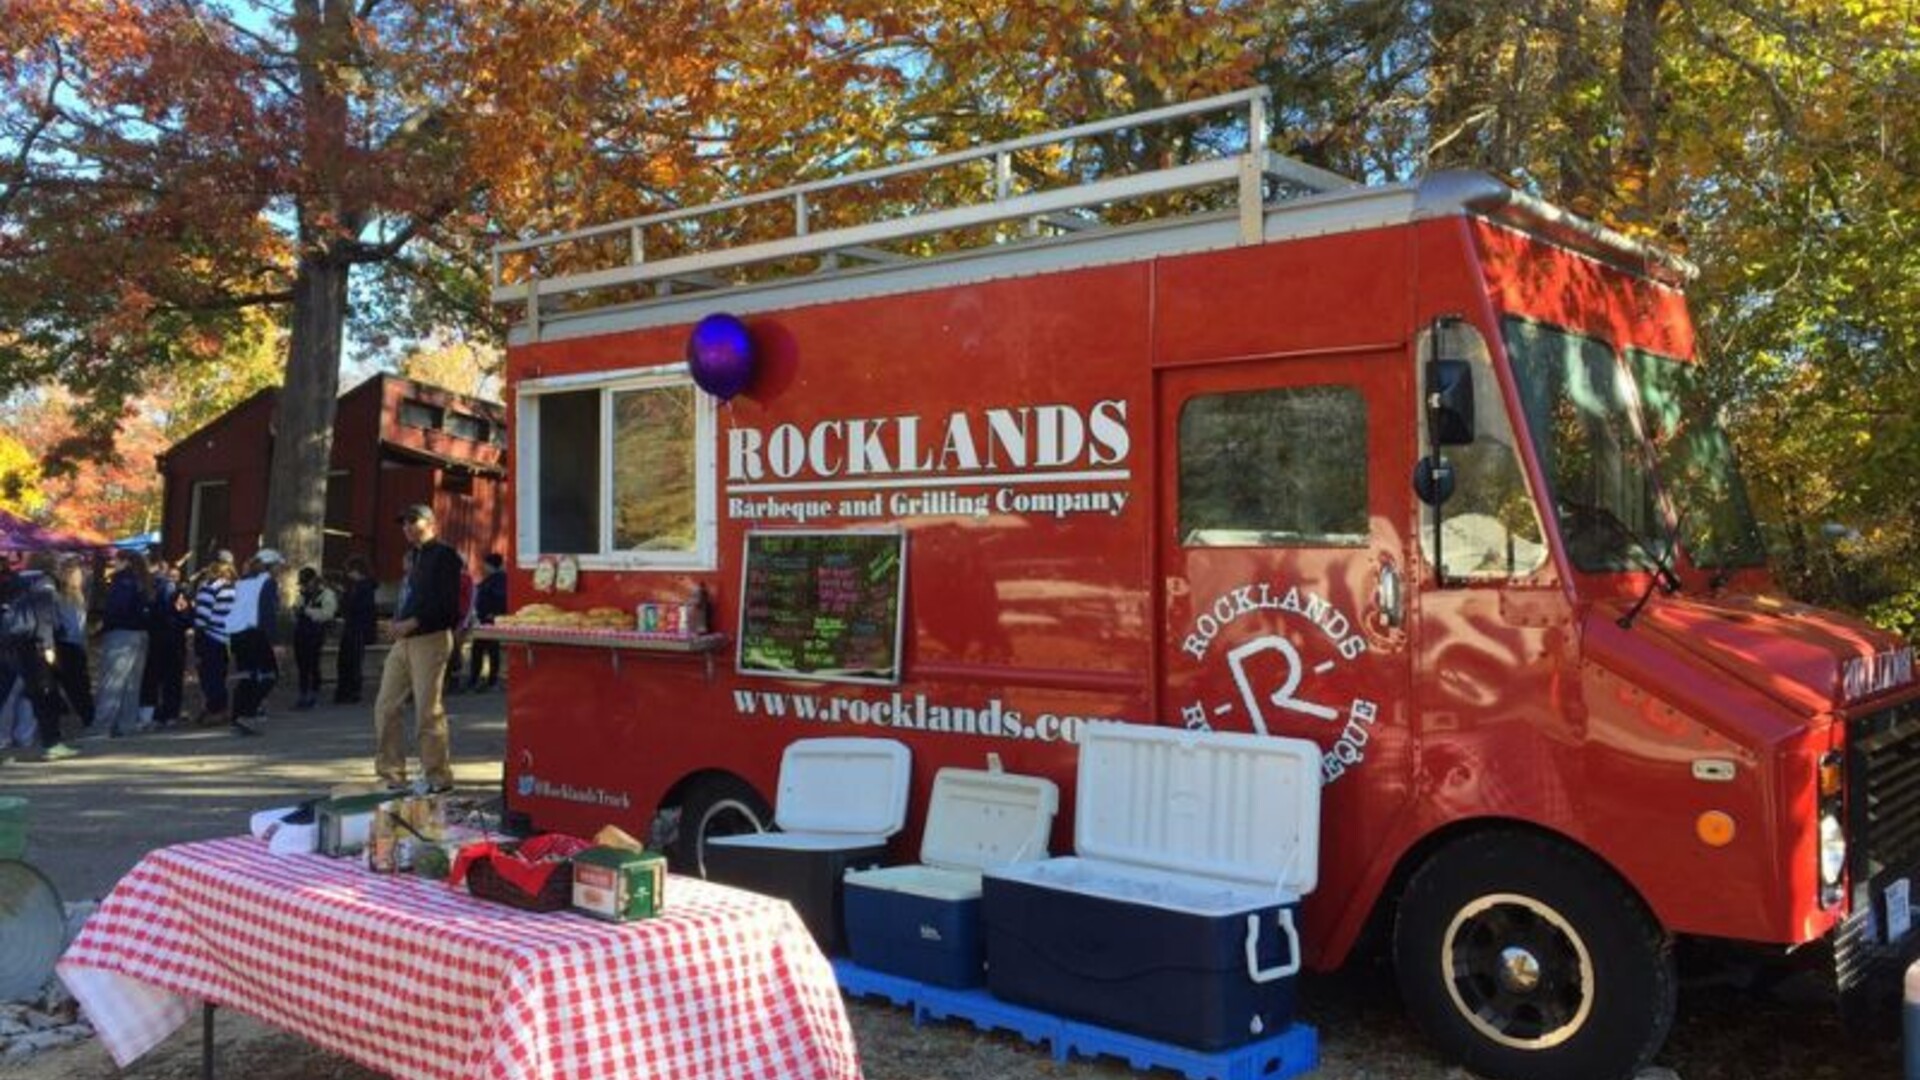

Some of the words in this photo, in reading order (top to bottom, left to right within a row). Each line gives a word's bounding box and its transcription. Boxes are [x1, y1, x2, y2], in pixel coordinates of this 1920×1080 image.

[728, 400, 1130, 482] ROCKLANDS
[728, 498, 832, 523] Barbeque
[839, 494, 882, 516] and
[889, 491, 988, 518] Grilling
[995, 488, 1129, 517] Company
[1183, 583, 1366, 661] ROCKLANDS
[733, 689, 1126, 744] www.rocklands.co
